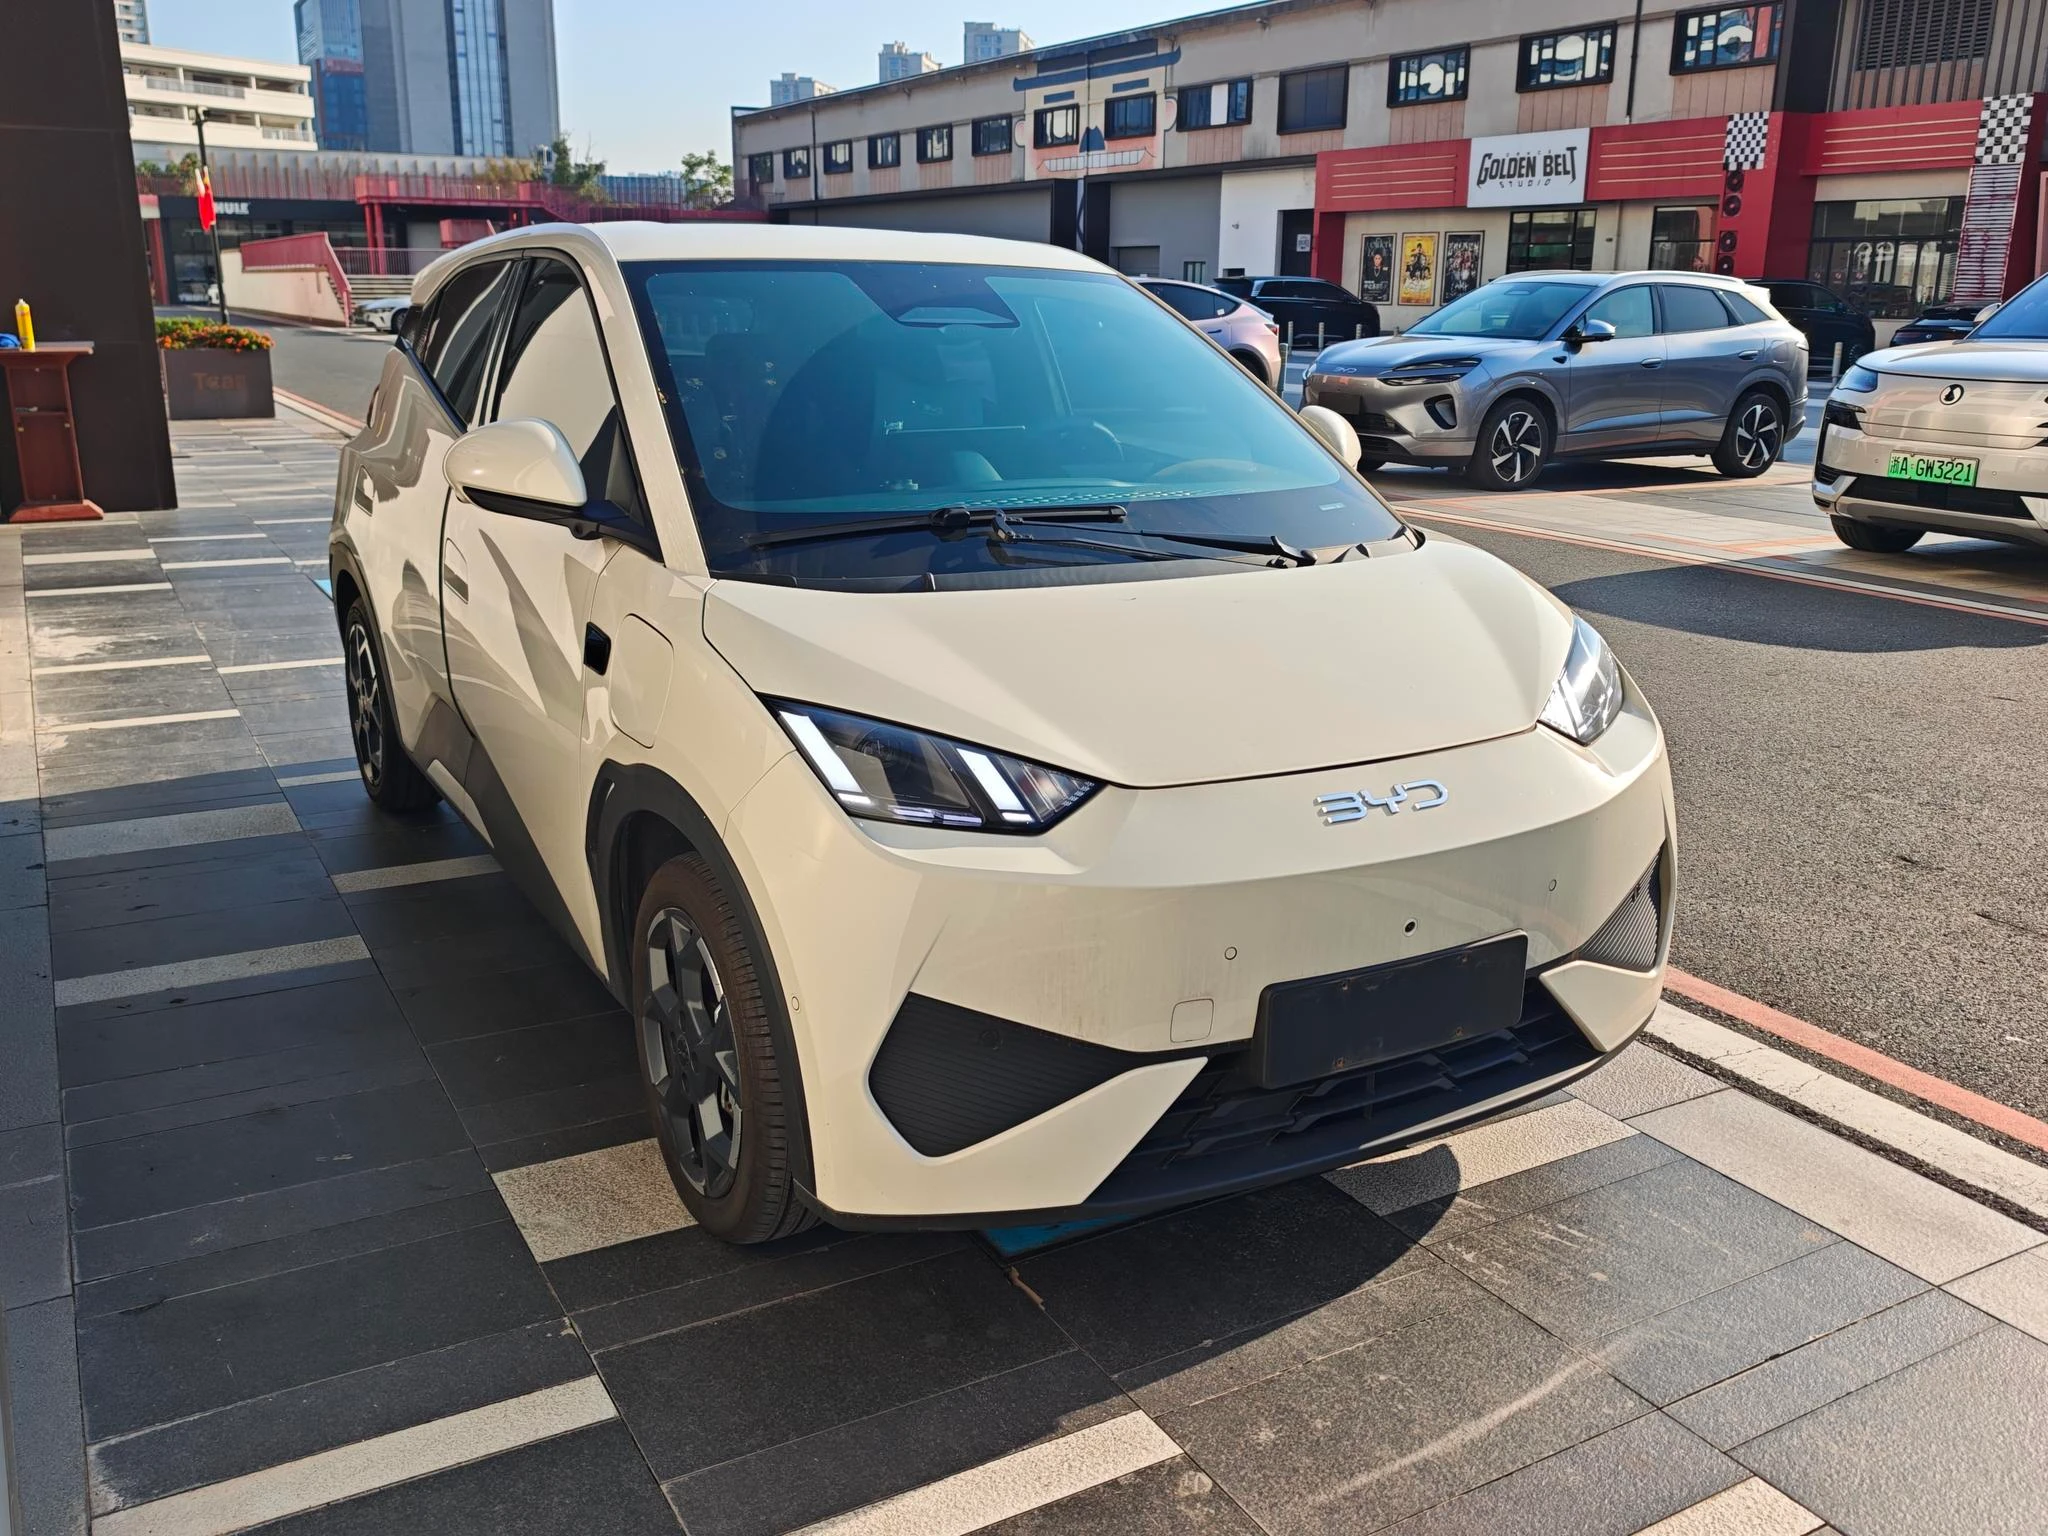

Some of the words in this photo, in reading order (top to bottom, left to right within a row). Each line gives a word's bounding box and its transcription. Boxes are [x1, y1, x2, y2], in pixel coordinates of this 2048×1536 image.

[1477, 152, 1537, 188] GOLDEN
[1543, 146, 1577, 184] BELT
[1499, 178, 1552, 188] STUDIO
[214, 201, 249, 214] HULE
[1916, 458, 1972, 482] GW3221
[1314, 779, 1448, 825] BYD
